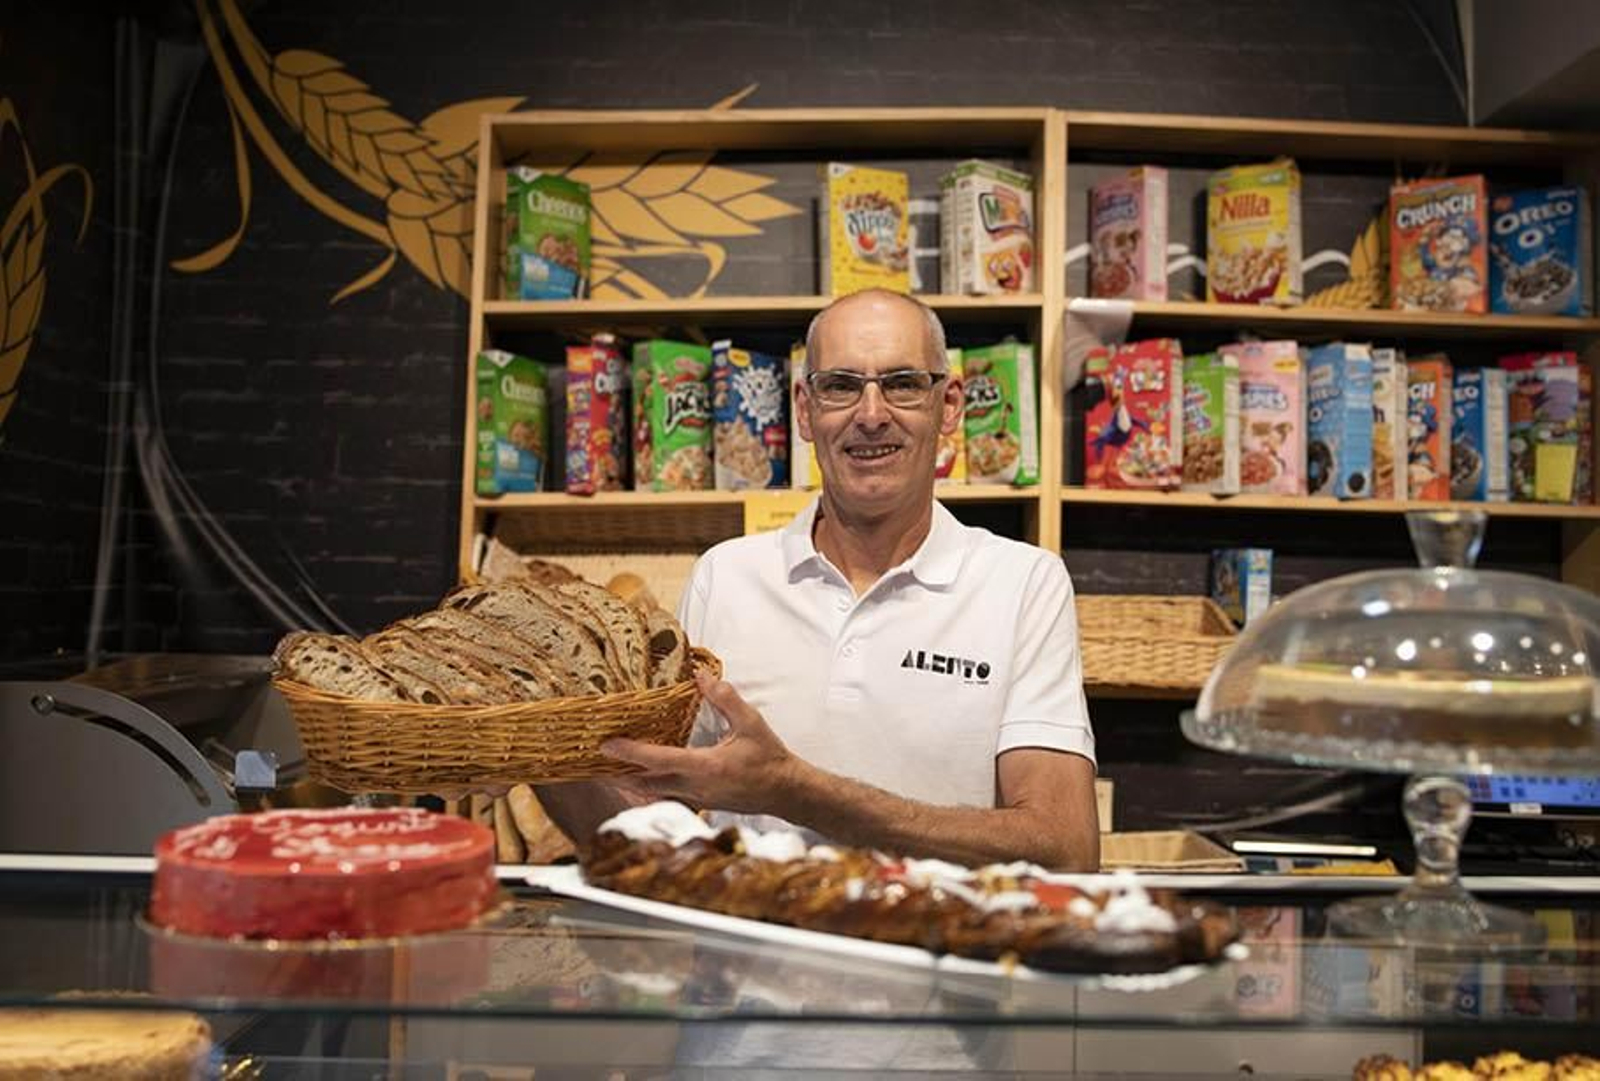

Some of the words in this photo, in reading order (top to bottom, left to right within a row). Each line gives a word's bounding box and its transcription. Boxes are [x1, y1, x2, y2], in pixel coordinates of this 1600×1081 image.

[1219, 193, 1270, 221] Nilla
[1397, 193, 1476, 229] CRUNCH
[1494, 201, 1573, 234] OREO
